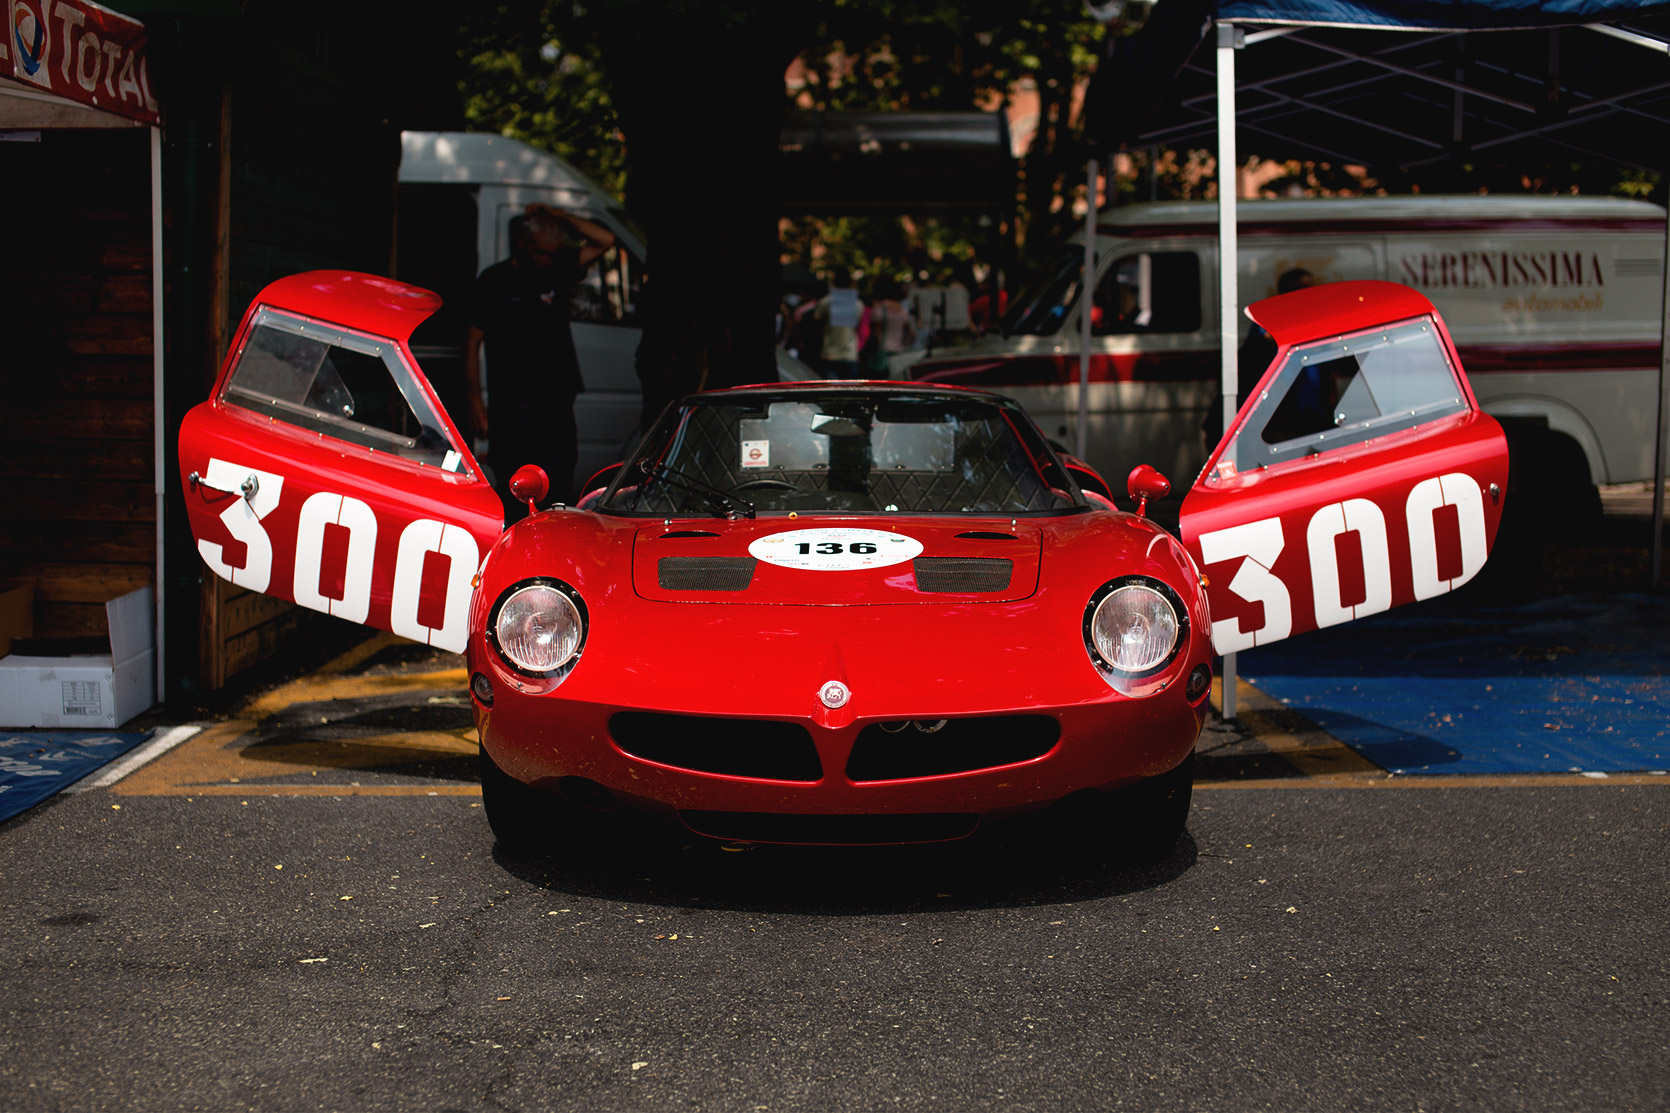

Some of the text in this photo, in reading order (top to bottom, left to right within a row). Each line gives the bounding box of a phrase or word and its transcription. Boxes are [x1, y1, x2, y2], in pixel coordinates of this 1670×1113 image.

[54, 1, 158, 112] TOTAL
[1401, 251, 1604, 288] SERENISSIMA
[1502, 292, 1604, 313] automobili
[197, 457, 480, 655] 300
[794, 542, 878, 555] 136
[1198, 472, 1489, 657] 300
